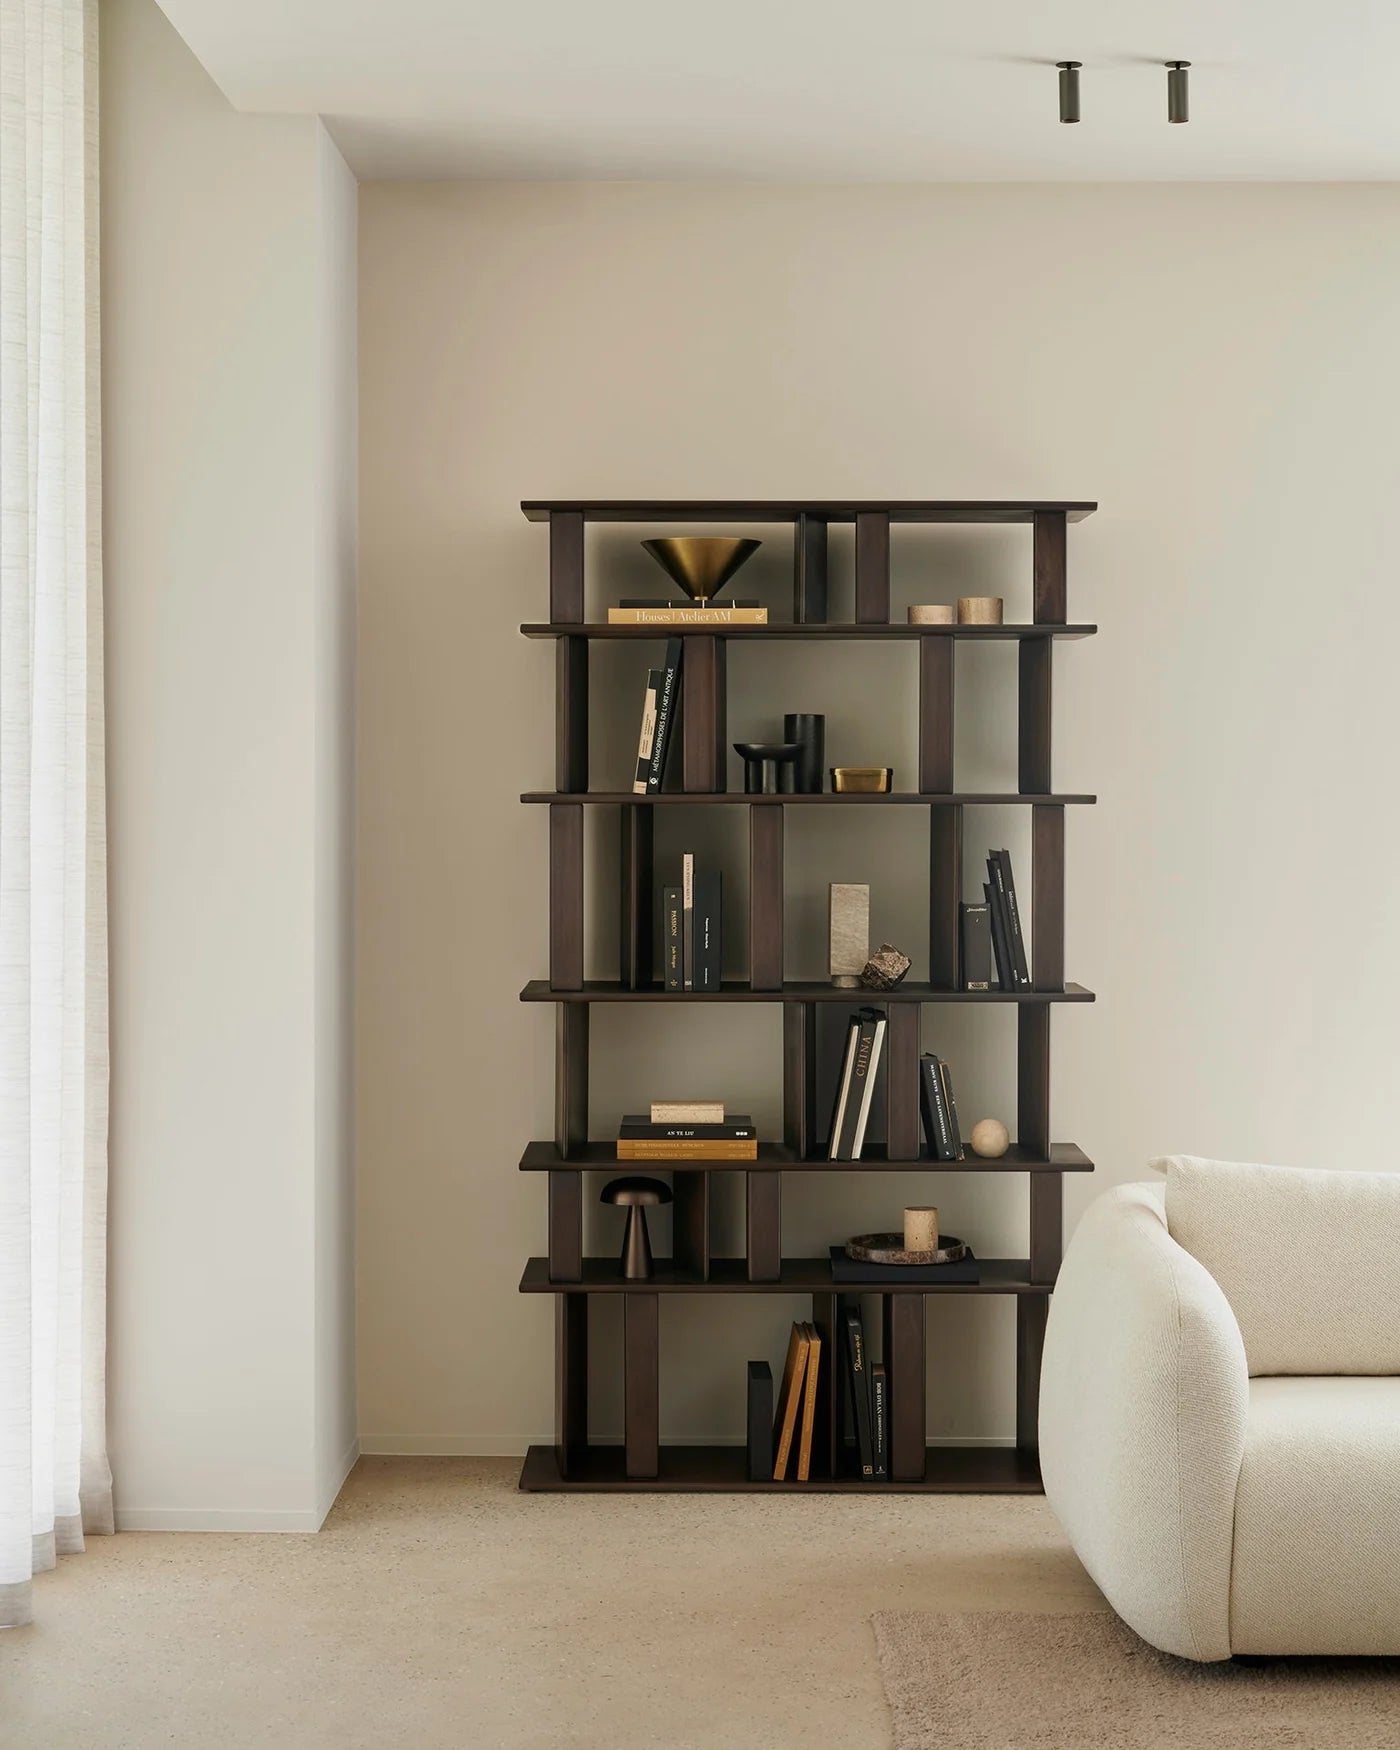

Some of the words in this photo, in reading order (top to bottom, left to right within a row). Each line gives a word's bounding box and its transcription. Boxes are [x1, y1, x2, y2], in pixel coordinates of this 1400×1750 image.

[636, 610, 671, 622] Houses
[679, 610, 710, 622] Atelier
[711, 610, 731, 622] AM
[660, 711, 667, 720] DE
[664, 668, 674, 694] ANTIQUE
[856, 1036, 871, 1077] CHINA
